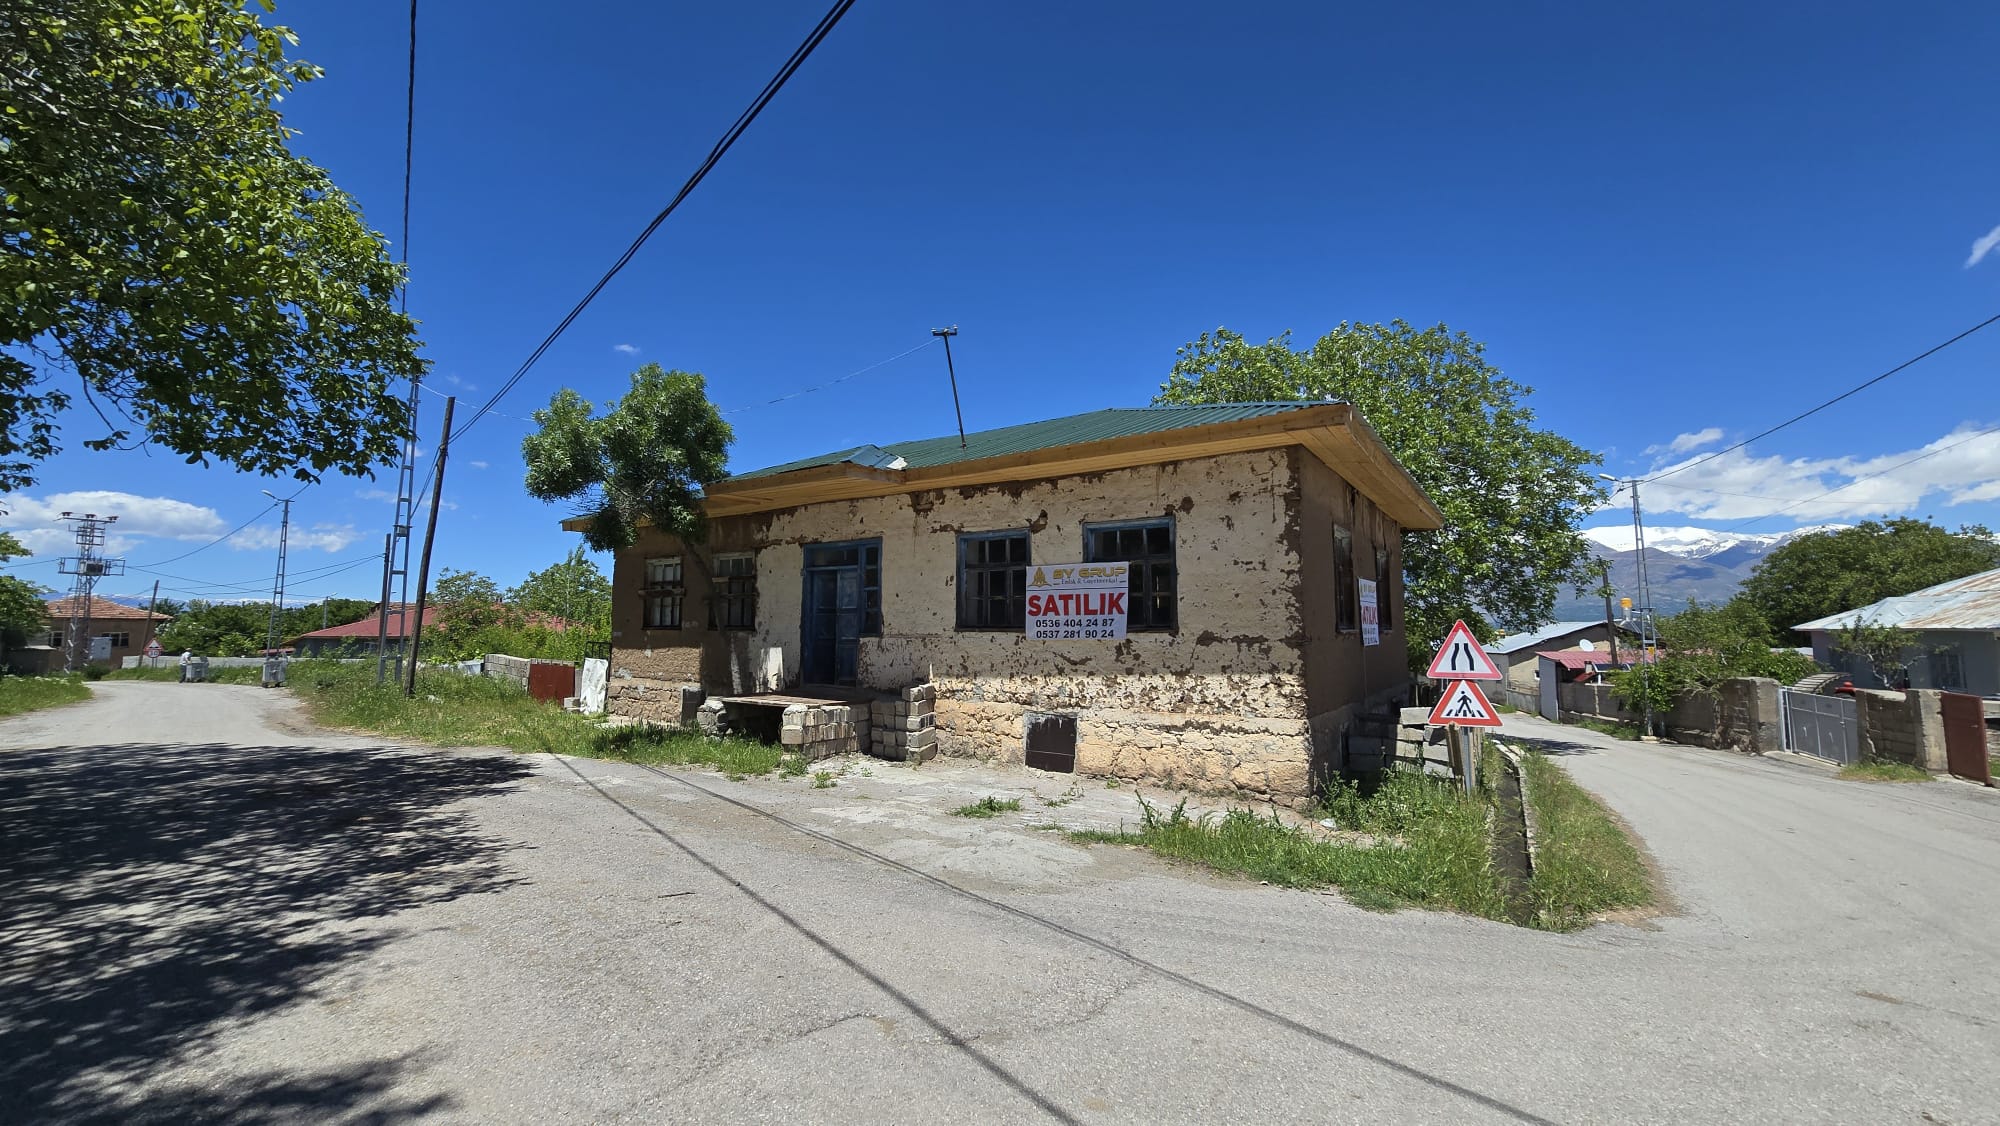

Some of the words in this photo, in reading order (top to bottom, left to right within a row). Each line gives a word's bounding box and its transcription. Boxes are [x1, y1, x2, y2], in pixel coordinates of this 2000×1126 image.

[1078, 567, 1127, 578] GRUP
[1028, 593, 1125, 616] SATILIK
[1035, 619, 1061, 628] 0536
[1063, 619, 1083, 628] 404
[1086, 619, 1098, 627] 24
[1102, 618, 1115, 627] 87
[1036, 630, 1060, 639] 0537
[1063, 630, 1081, 638] 281
[1085, 630, 1098, 638] 90
[1101, 629, 1114, 638] 24
